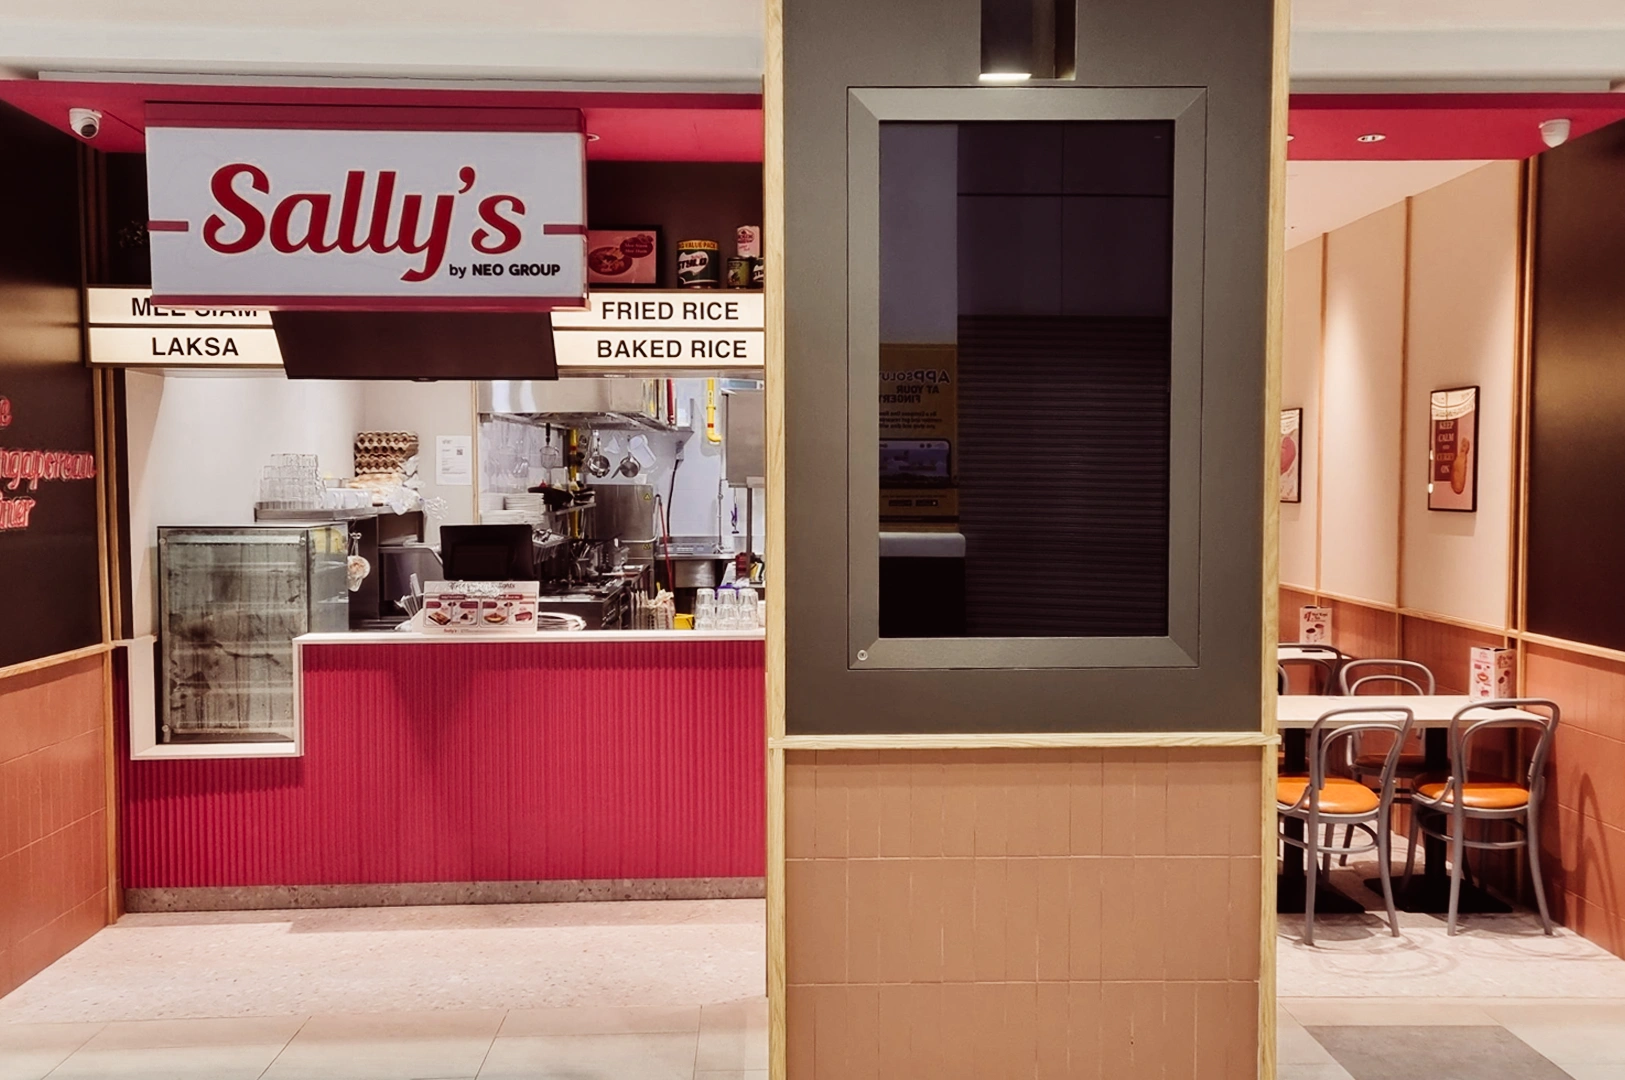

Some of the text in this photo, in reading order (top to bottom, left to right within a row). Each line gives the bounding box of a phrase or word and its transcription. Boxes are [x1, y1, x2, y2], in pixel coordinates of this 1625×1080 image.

[203, 163, 526, 282] Sally's
[449, 264, 561, 279] by NEO GROUP
[602, 302, 739, 320] FRIED RICE
[152, 337, 239, 356] LAKSA
[597, 340, 747, 358] BAKED RICE
[1439, 421, 1454, 430] KEEP
